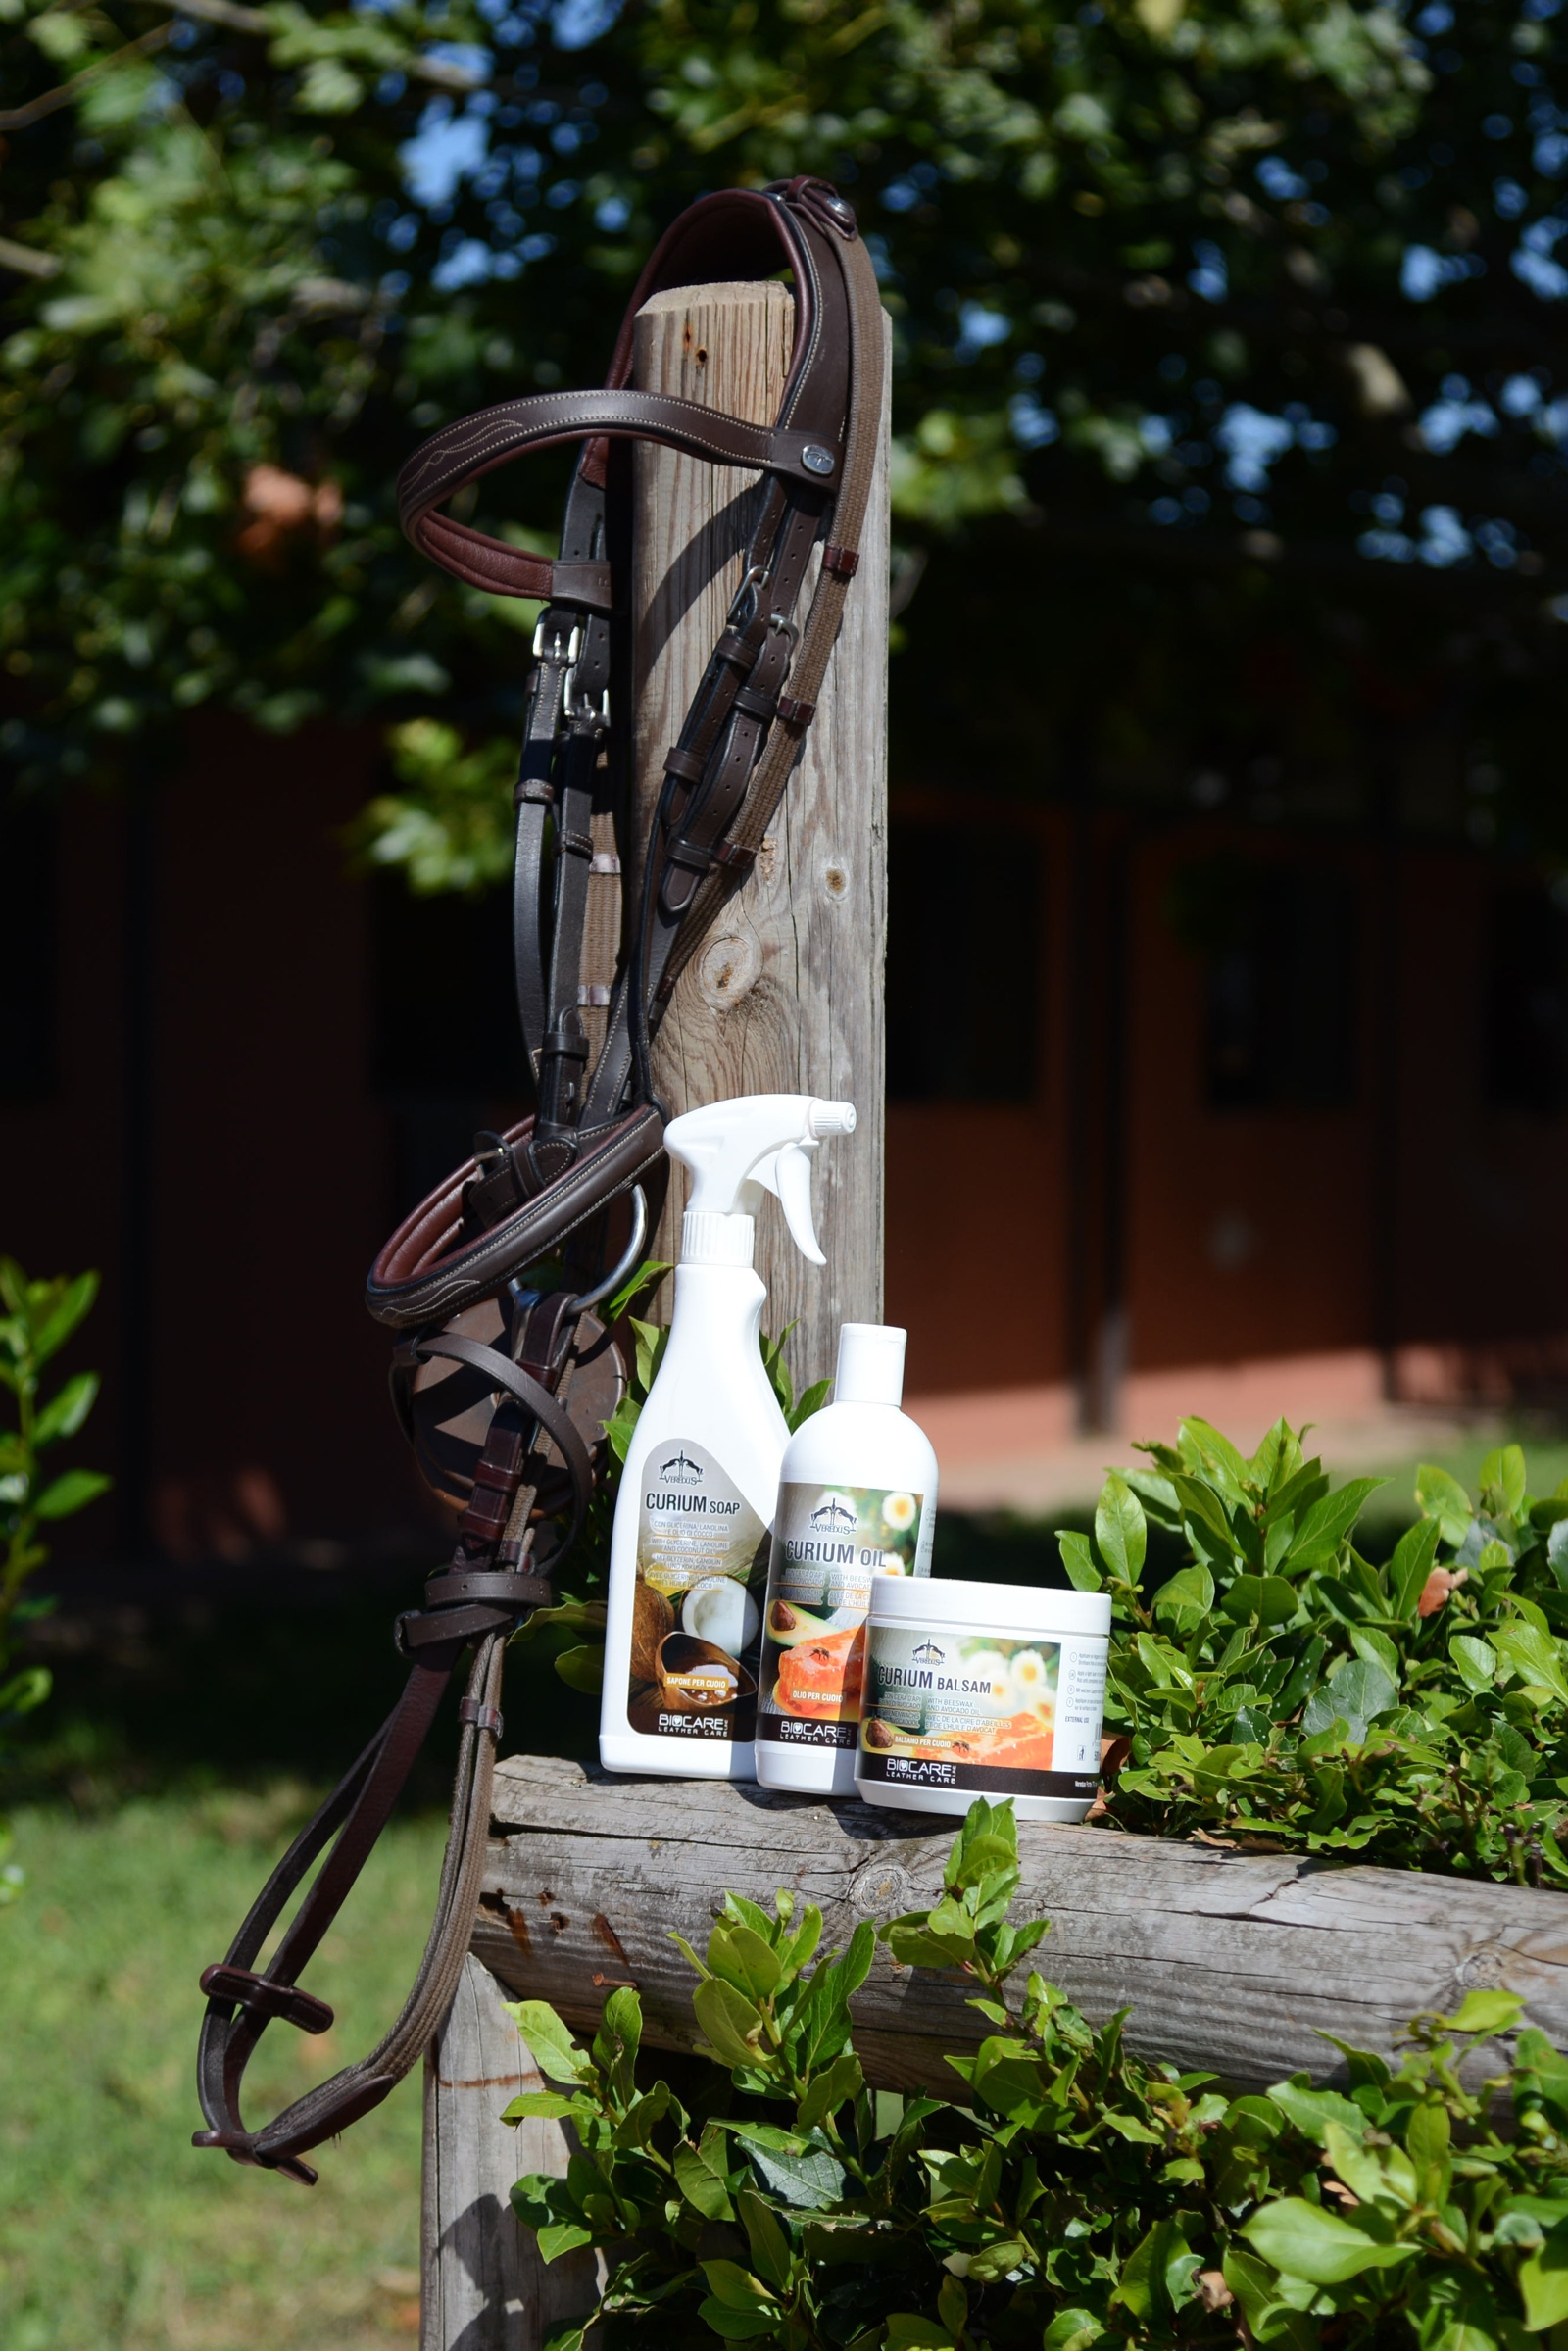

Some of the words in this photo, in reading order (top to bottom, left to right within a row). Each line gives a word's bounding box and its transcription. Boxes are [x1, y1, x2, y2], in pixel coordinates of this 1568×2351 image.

[664, 1475, 697, 1485] VEREDUS
[646, 1493, 707, 1512] CURIUM
[710, 1501, 740, 1514] SOAP
[815, 1523, 851, 1535] VEREDUS
[786, 1540, 855, 1564] CURIUM
[860, 1548, 886, 1567] OIL
[915, 1657, 942, 1666] VEREDUS
[666, 1676, 690, 1686] SAPONE
[692, 1678, 704, 1687] PER
[706, 1679, 725, 1689] CUOIO
[878, 1666, 933, 1689] CURIUM
[937, 1677, 991, 1694] BALSAM
[792, 1690, 807, 1699] OLIO
[808, 1691, 820, 1700] PER
[821, 1693, 843, 1703] CUOIO
[944, 1698, 973, 1707] BEESWAX
[941, 1706, 969, 1715] AVOCADO
[659, 1713, 724, 1731] BIOCARE
[976, 1719, 1010, 1728] D'ABEILLES
[658, 1726, 698, 1735] LEATHER
[704, 1729, 728, 1738] CARE
[780, 1720, 847, 1739] BIOCARE
[943, 1723, 965, 1732] L'HUILE
[967, 1725, 995, 1734] D'AVOCAT
[779, 1733, 819, 1742] LEATHER
[825, 1737, 851, 1745] CARE
[895, 1736, 918, 1744] BALSAMO
[932, 1739, 951, 1748] CUOIO
[886, 1758, 952, 1777] BIOCARE
[886, 1770, 924, 1781] LEATHER
[930, 1775, 956, 1784] CARE
